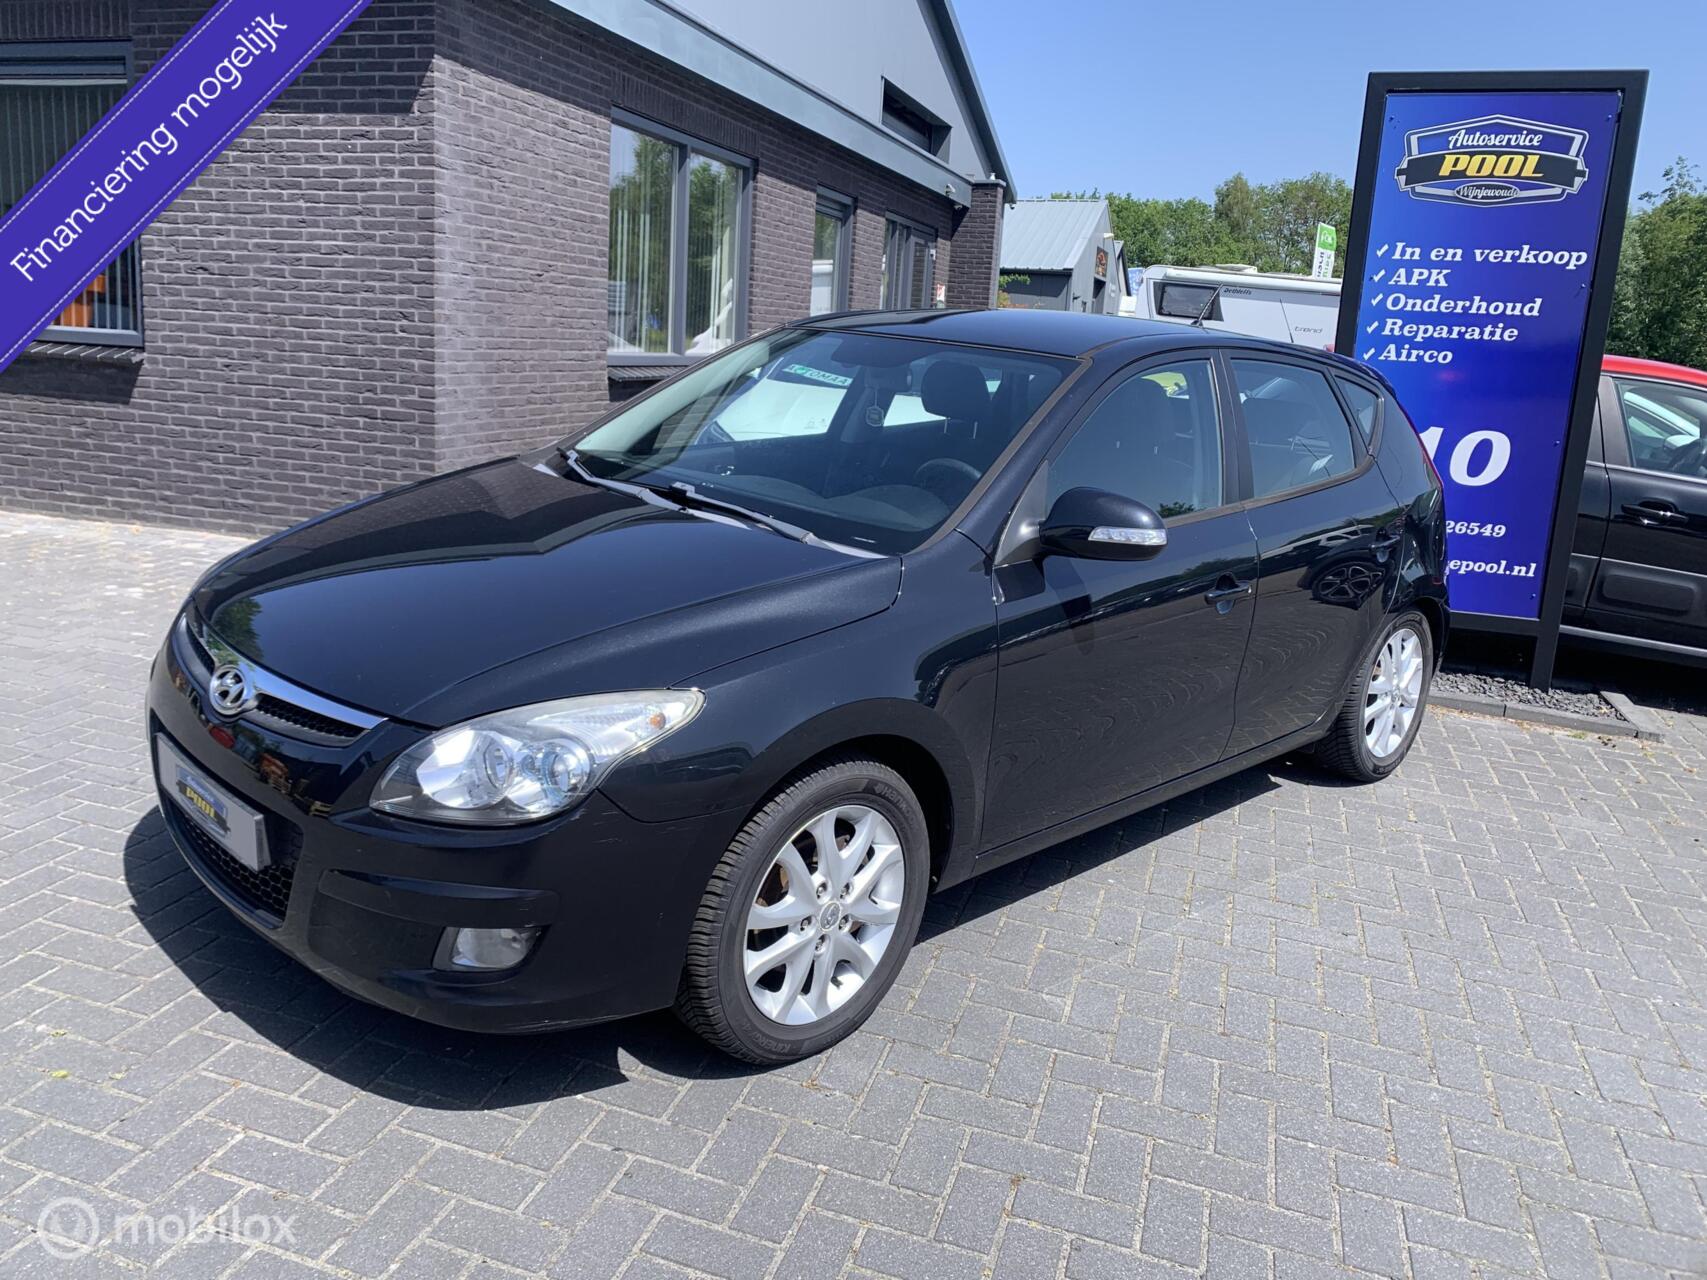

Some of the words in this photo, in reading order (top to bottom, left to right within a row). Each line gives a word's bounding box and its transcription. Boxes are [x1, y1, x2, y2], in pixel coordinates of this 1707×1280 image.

[1448, 129, 1543, 149] Autoservice
[1438, 154, 1544, 177] POOL
[1392, 242, 1420, 260] In
[1430, 247, 1462, 261] en
[1474, 245, 1587, 269] verkoop
[1388, 268, 1451, 287] APK
[1386, 293, 1542, 317] Onderhoud
[1381, 318, 1519, 342] Reparatie
[1378, 343, 1453, 364] Airco
